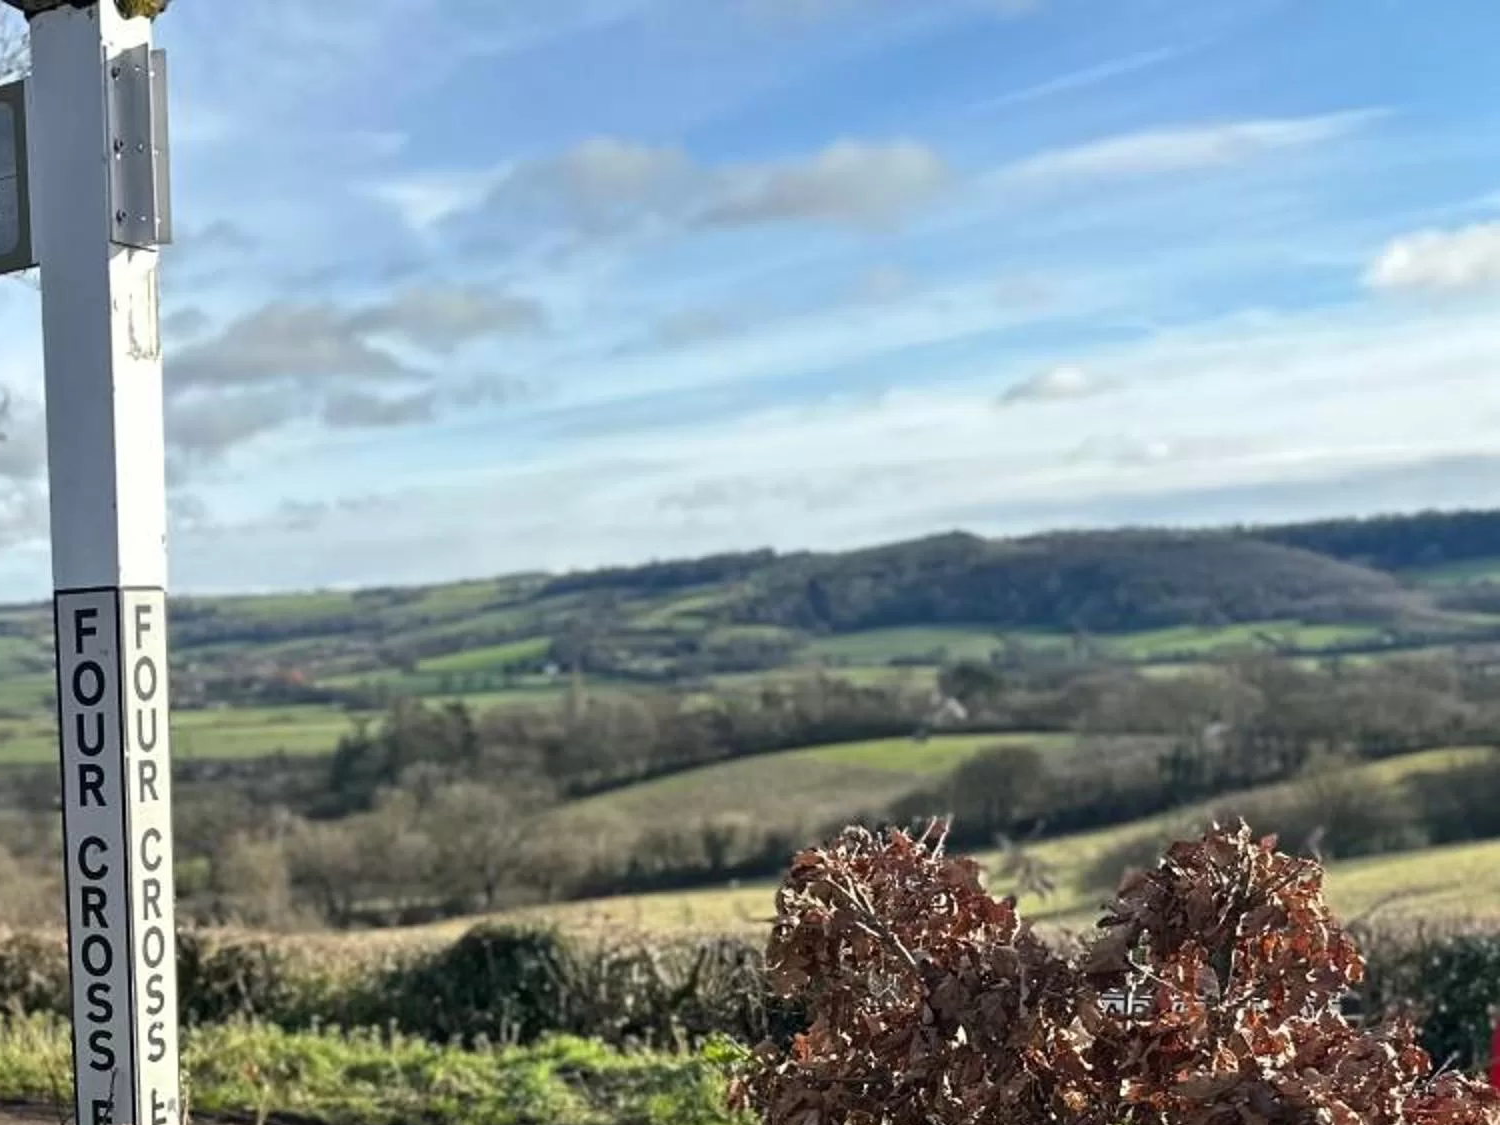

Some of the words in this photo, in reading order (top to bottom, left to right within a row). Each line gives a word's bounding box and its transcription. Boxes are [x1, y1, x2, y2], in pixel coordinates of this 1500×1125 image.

[72, 607, 107, 808] FOUR
[133, 604, 160, 802] FOUR
[77, 835, 116, 1072] CROSS
[139, 827, 167, 1063] CROSS
